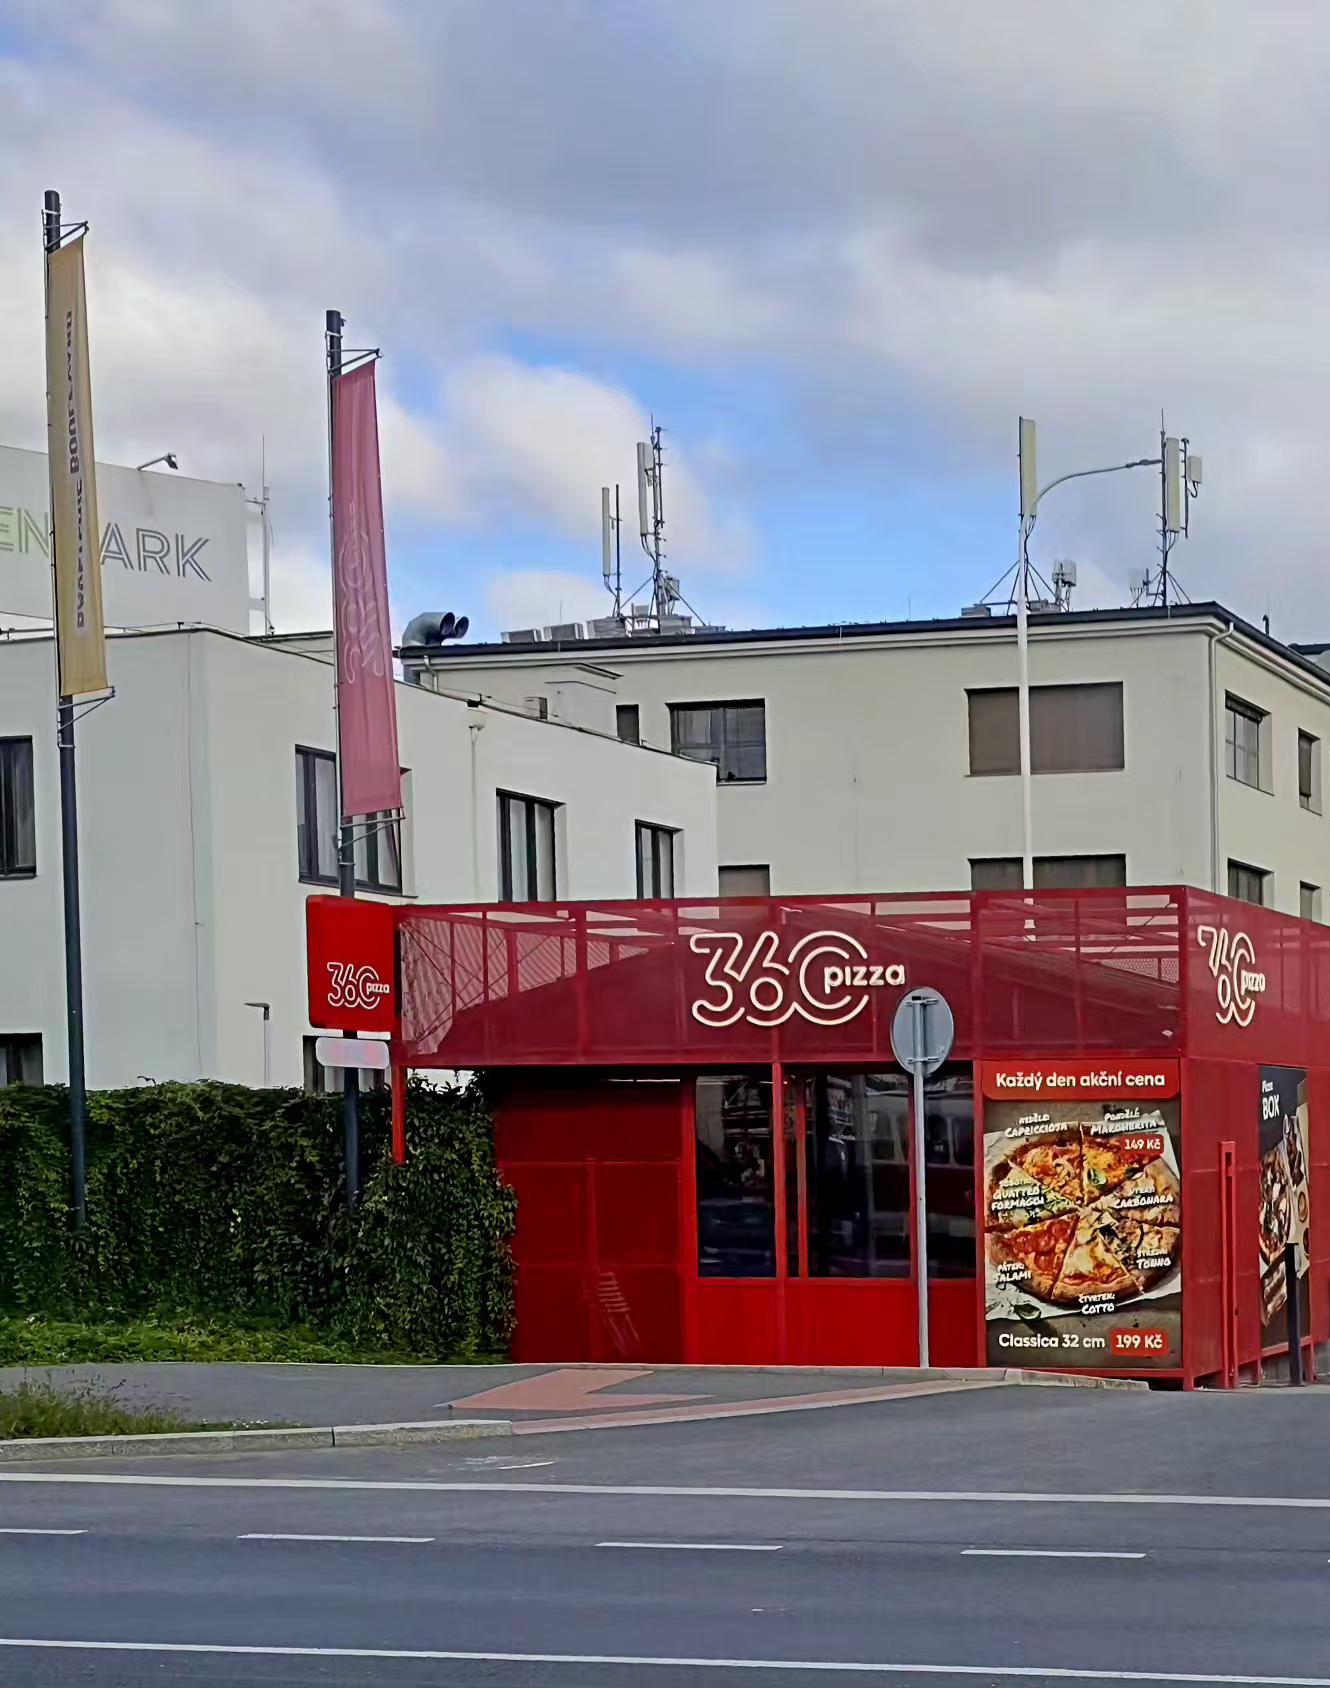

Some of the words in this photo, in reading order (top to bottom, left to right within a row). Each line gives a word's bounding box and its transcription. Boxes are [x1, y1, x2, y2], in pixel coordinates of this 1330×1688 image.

[690, 930, 869, 1027] 360
[824, 964, 905, 994] pizza
[1197, 925, 1255, 1027] 360
[327, 962, 380, 1009] 360
[366, 983, 390, 995] pizza
[996, 1072, 1043, 1091] Každý
[1046, 1073, 1076, 1087] den
[1080, 1071, 1122, 1087] akční
[1125, 1074, 1165, 1087] cena
[1262, 1095, 1280, 1120] BOX
[1124, 1139, 1144, 1150] 149
[1147, 1138, 1161, 1150] Kč
[1115, 1194, 1173, 1209] CARBONARA
[1081, 1303, 1115, 1315] COTTO
[999, 1334, 1059, 1348] Classica
[1062, 1334, 1079, 1348] 32
[1083, 1337, 1105, 1348] cm
[1116, 1335, 1140, 1348] 199
[1145, 1334, 1163, 1349] Kč
